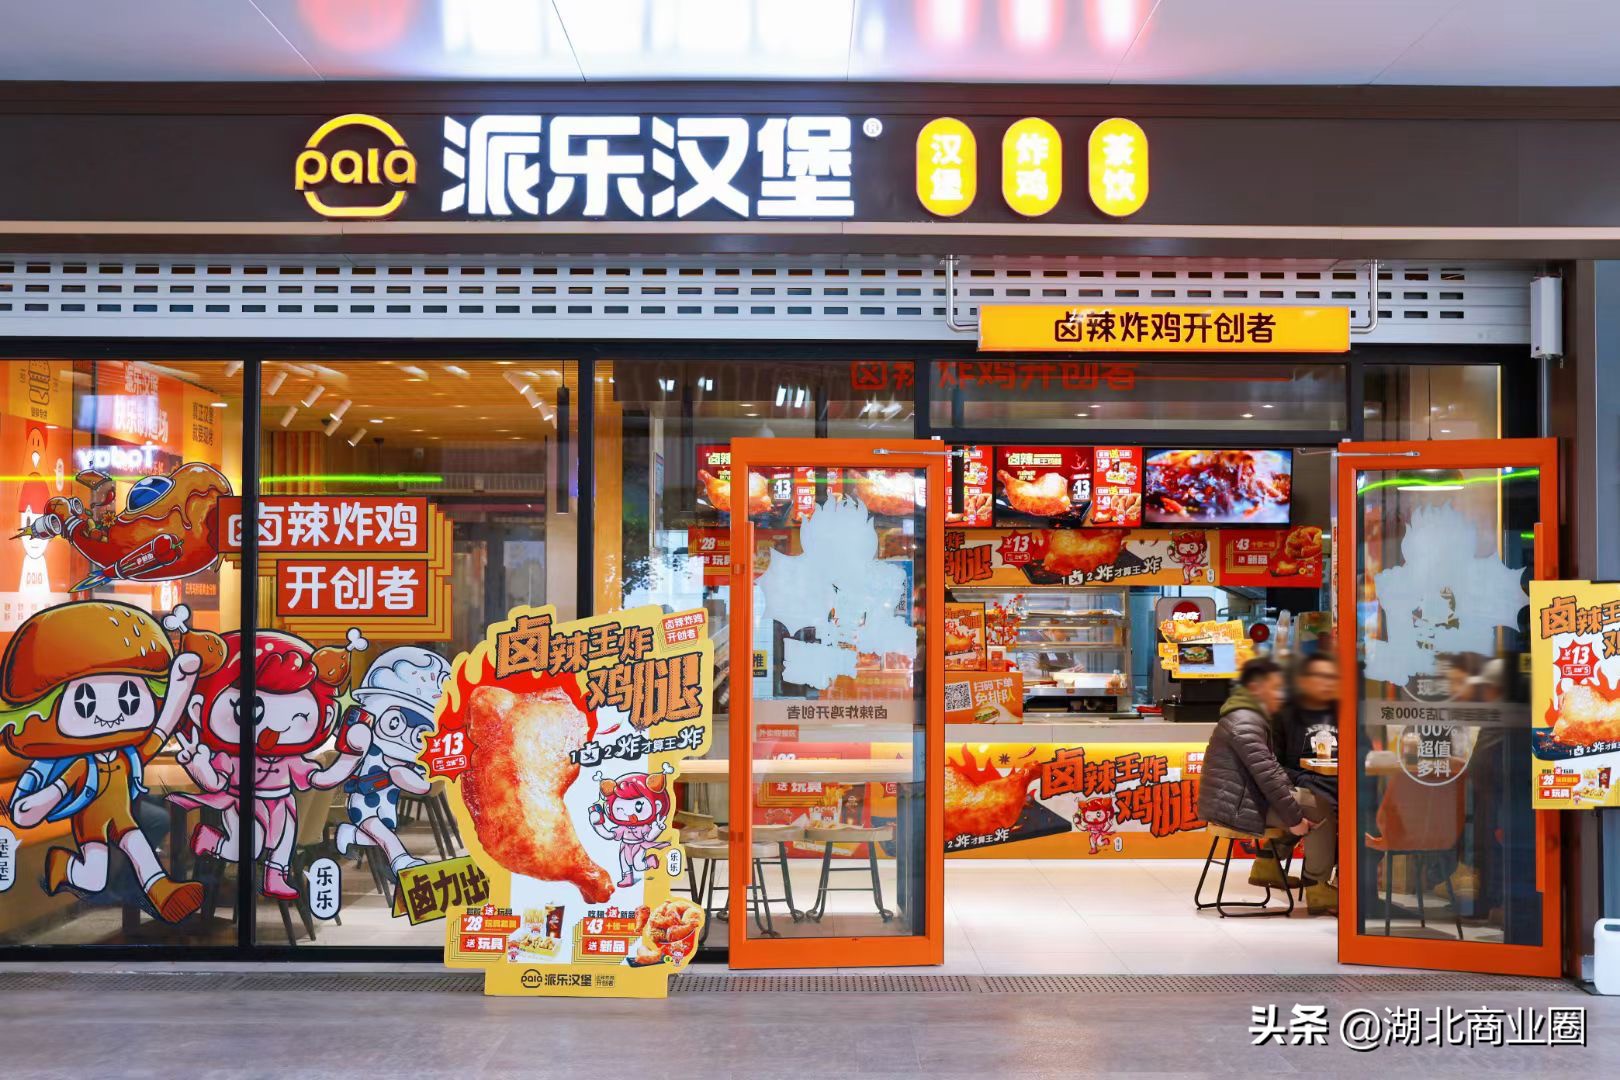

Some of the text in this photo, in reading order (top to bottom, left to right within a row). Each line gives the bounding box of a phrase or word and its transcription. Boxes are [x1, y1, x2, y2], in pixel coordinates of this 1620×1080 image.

[441, 115, 855, 217] 派乐汉堡
[930, 133, 962, 200] 汉堡
[1016, 133, 1049, 200] 炸鸡
[1102, 133, 1136, 201] 茶饮
[1054, 310, 1276, 343] 卤辣炸鸡开创者
[228, 502, 417, 546] 卤辣炸鸡
[285, 566, 418, 609] 开创者
[664, 610, 705, 630] 卤辣炸鸡
[666, 629, 698, 642] 开创者
[496, 614, 653, 679] 卤辣王炸
[586, 652, 702, 730] 鸡腿
[1417, 741, 1451, 758] 超值
[1417, 760, 1451, 778] 多料
[1040, 747, 1168, 800] 卤辣王炸
[669, 852, 679, 873] 乐乐
[315, 866, 333, 909] 乐乐
[544, 974, 592, 986] 派乐汉堡
